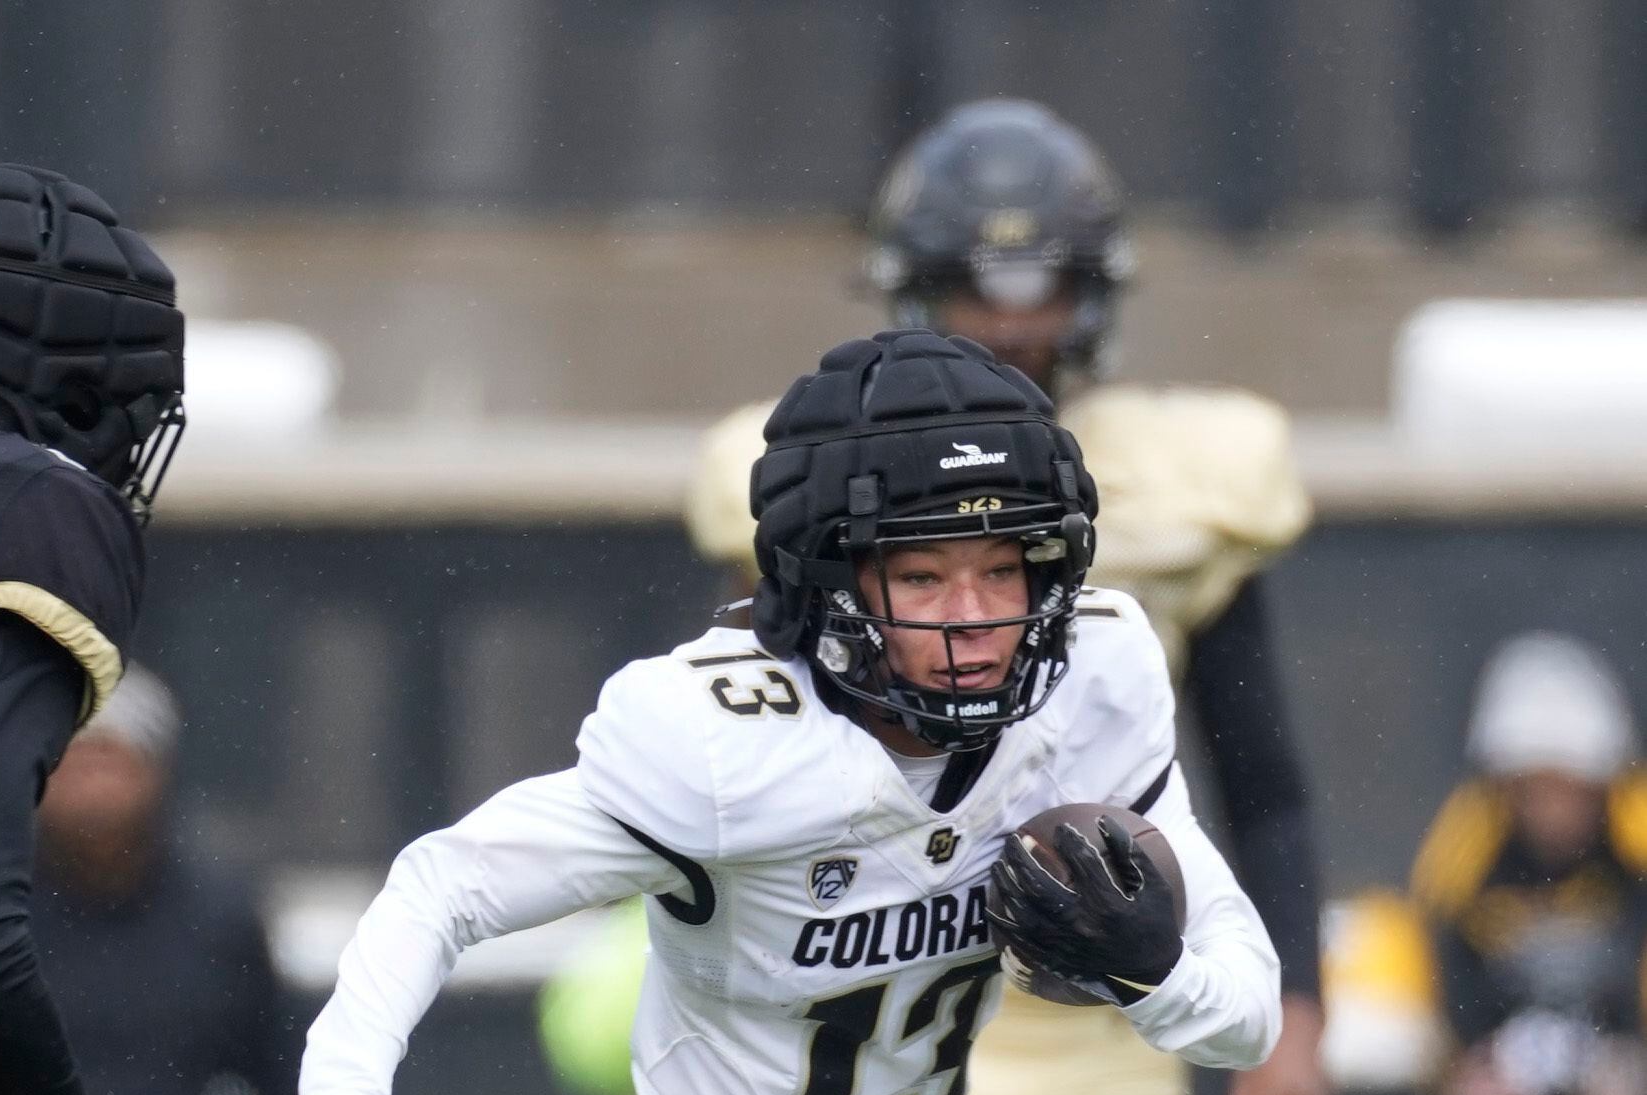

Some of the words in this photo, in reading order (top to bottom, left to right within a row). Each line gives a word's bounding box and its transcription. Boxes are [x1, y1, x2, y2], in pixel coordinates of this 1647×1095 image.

[939, 452, 1009, 469] GUARDIAN
[684, 647, 803, 720] 13
[815, 880, 844, 900] 12
[792, 885, 990, 968] COLORA
